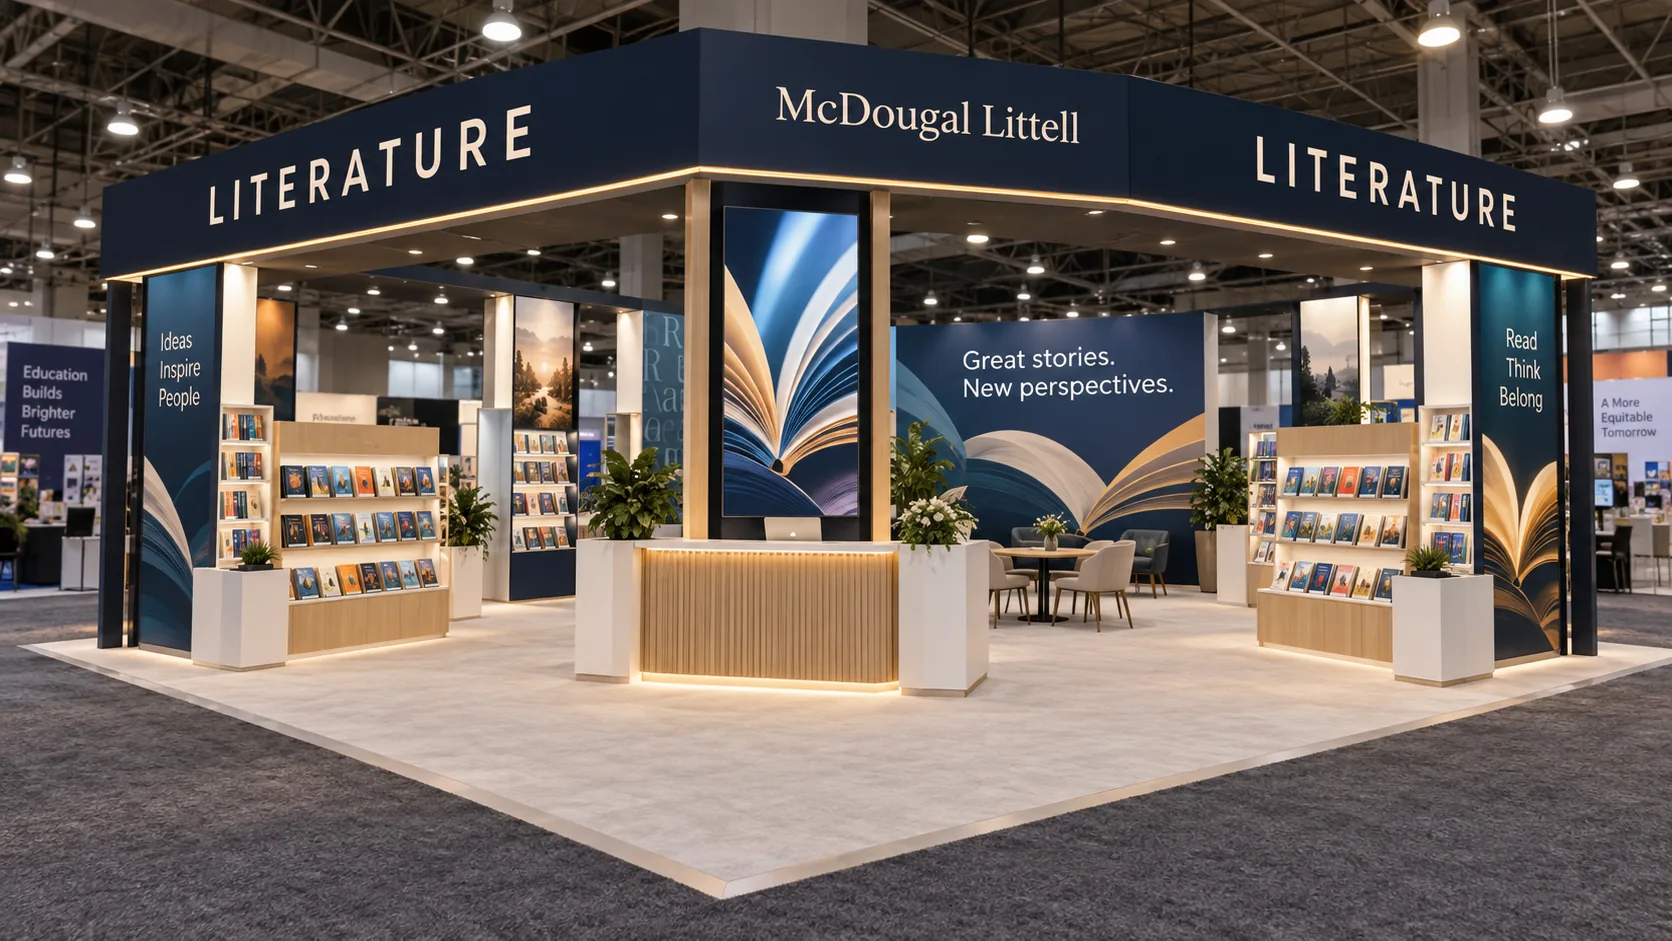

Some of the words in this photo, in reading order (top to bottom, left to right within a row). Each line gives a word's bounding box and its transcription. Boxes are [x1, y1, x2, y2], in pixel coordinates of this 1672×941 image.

[775, 86, 972, 142] McDougal
[982, 104, 1080, 144] Littell
[209, 104, 532, 226] LITERATURE
[1256, 136, 1516, 232] LITERATURE
[160, 331, 193, 352] Ideas
[1506, 328, 1538, 351] Read
[160, 358, 201, 382] Inspire
[963, 350, 1026, 371] Great
[1032, 346, 1115, 369] stories.
[1506, 357, 1541, 380] Think
[23, 365, 88, 382] Education
[22, 385, 63, 400] Builds
[158, 386, 201, 412] People
[963, 378, 1013, 398] New
[1020, 374, 1174, 402] perspectives.
[1499, 386, 1543, 413] Belong
[22, 405, 76, 422] Brighter
[1600, 398, 1610, 409] A
[1612, 397, 1640, 409] More
[1600, 411, 1653, 426] Equitable
[20, 424, 71, 439] Futures
[1601, 427, 1657, 438] Tomorrow
